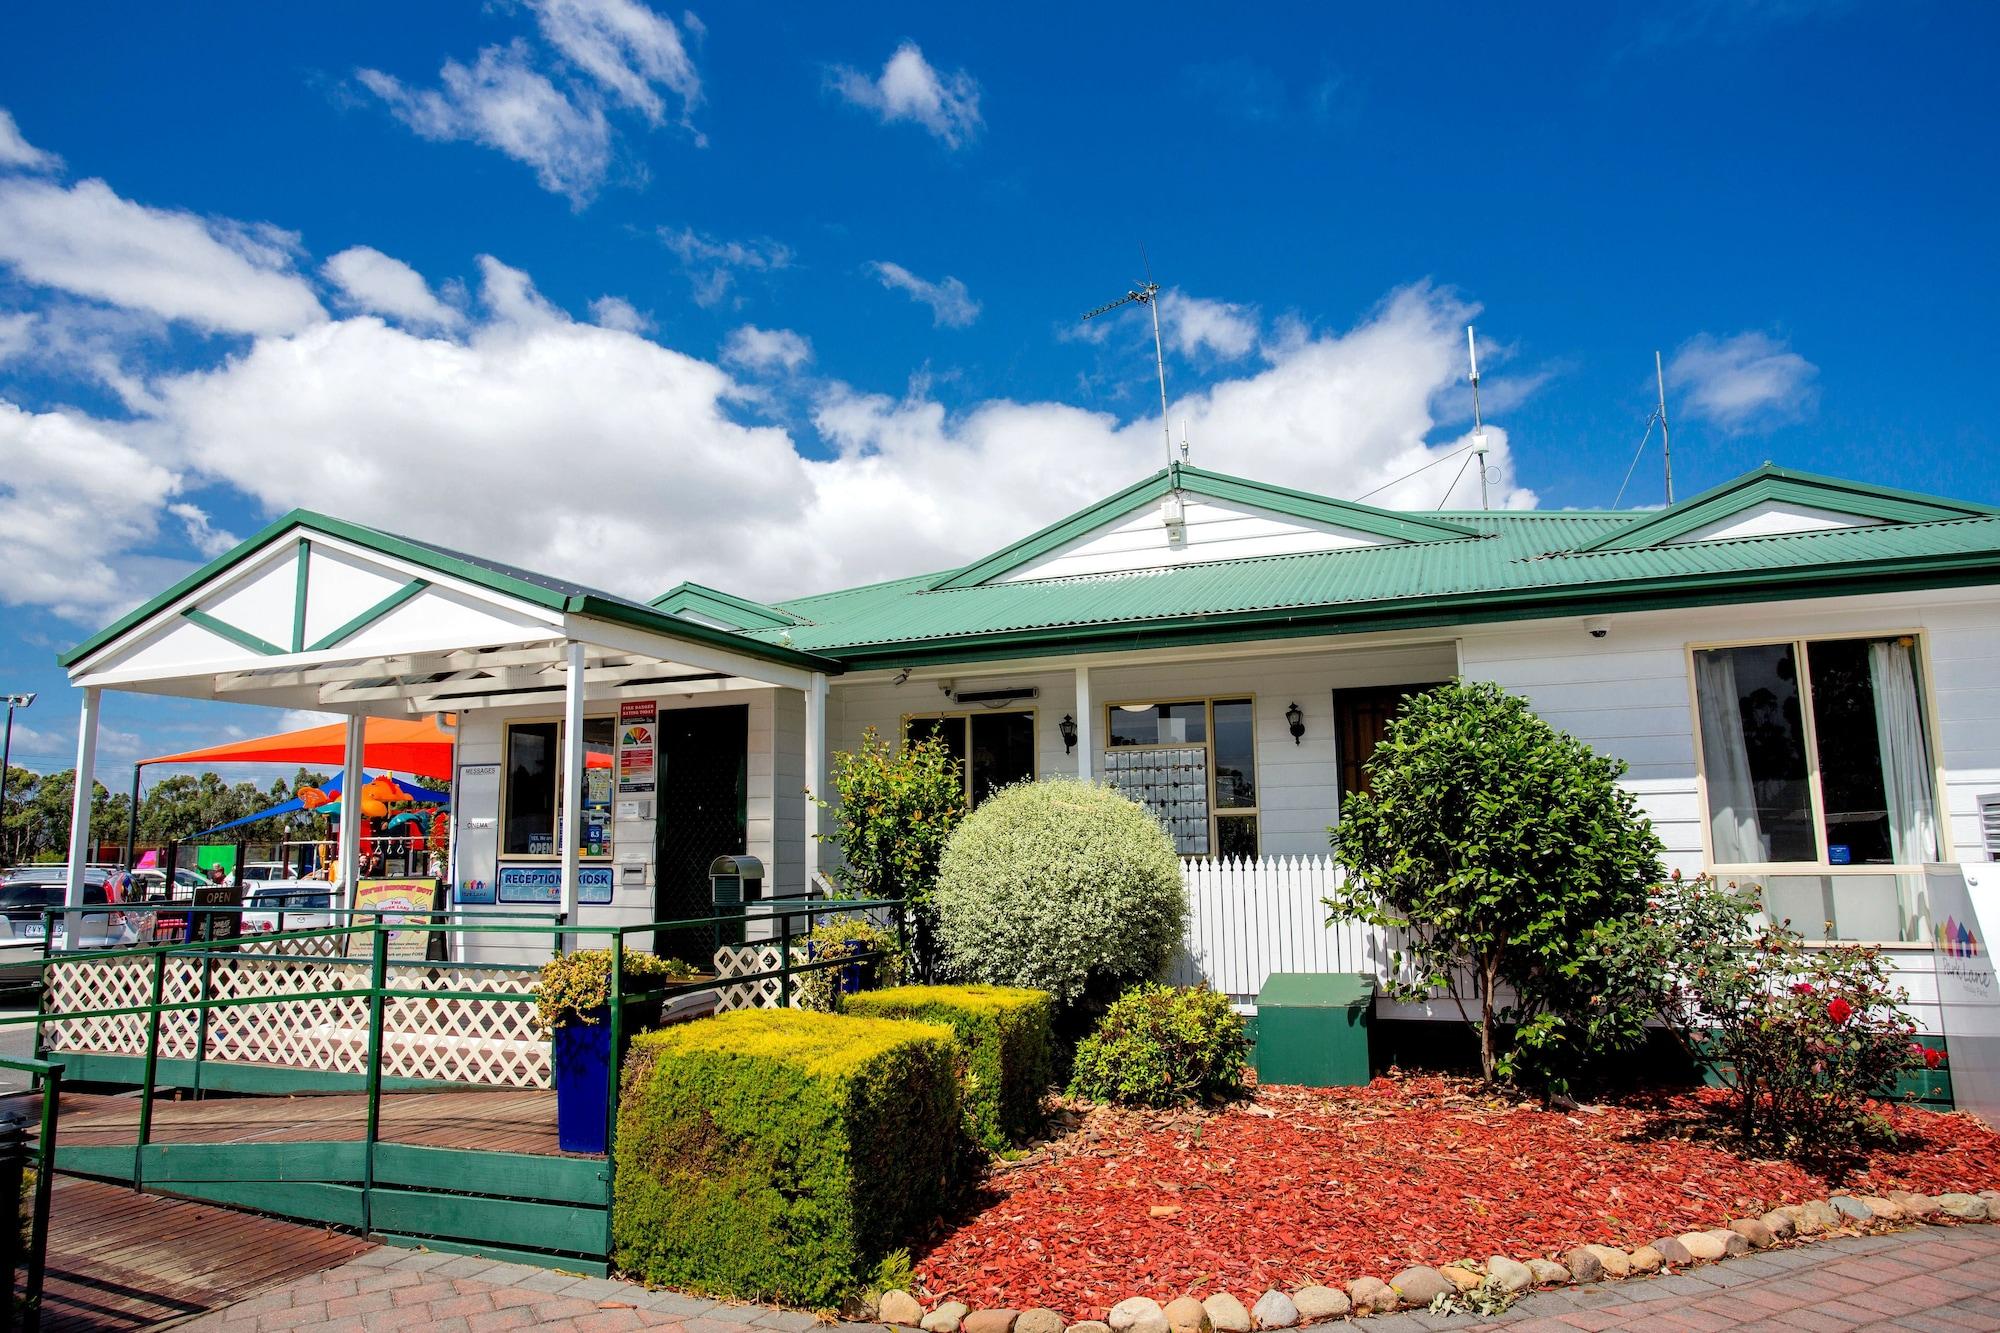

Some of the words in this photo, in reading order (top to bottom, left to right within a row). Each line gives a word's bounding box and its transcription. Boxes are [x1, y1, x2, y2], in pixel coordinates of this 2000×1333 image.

[590, 830, 600, 838] 8.5
[529, 842, 553, 854] OPEN
[505, 874, 561, 884] RECEPTION
[206, 892, 232, 904] OPEN
